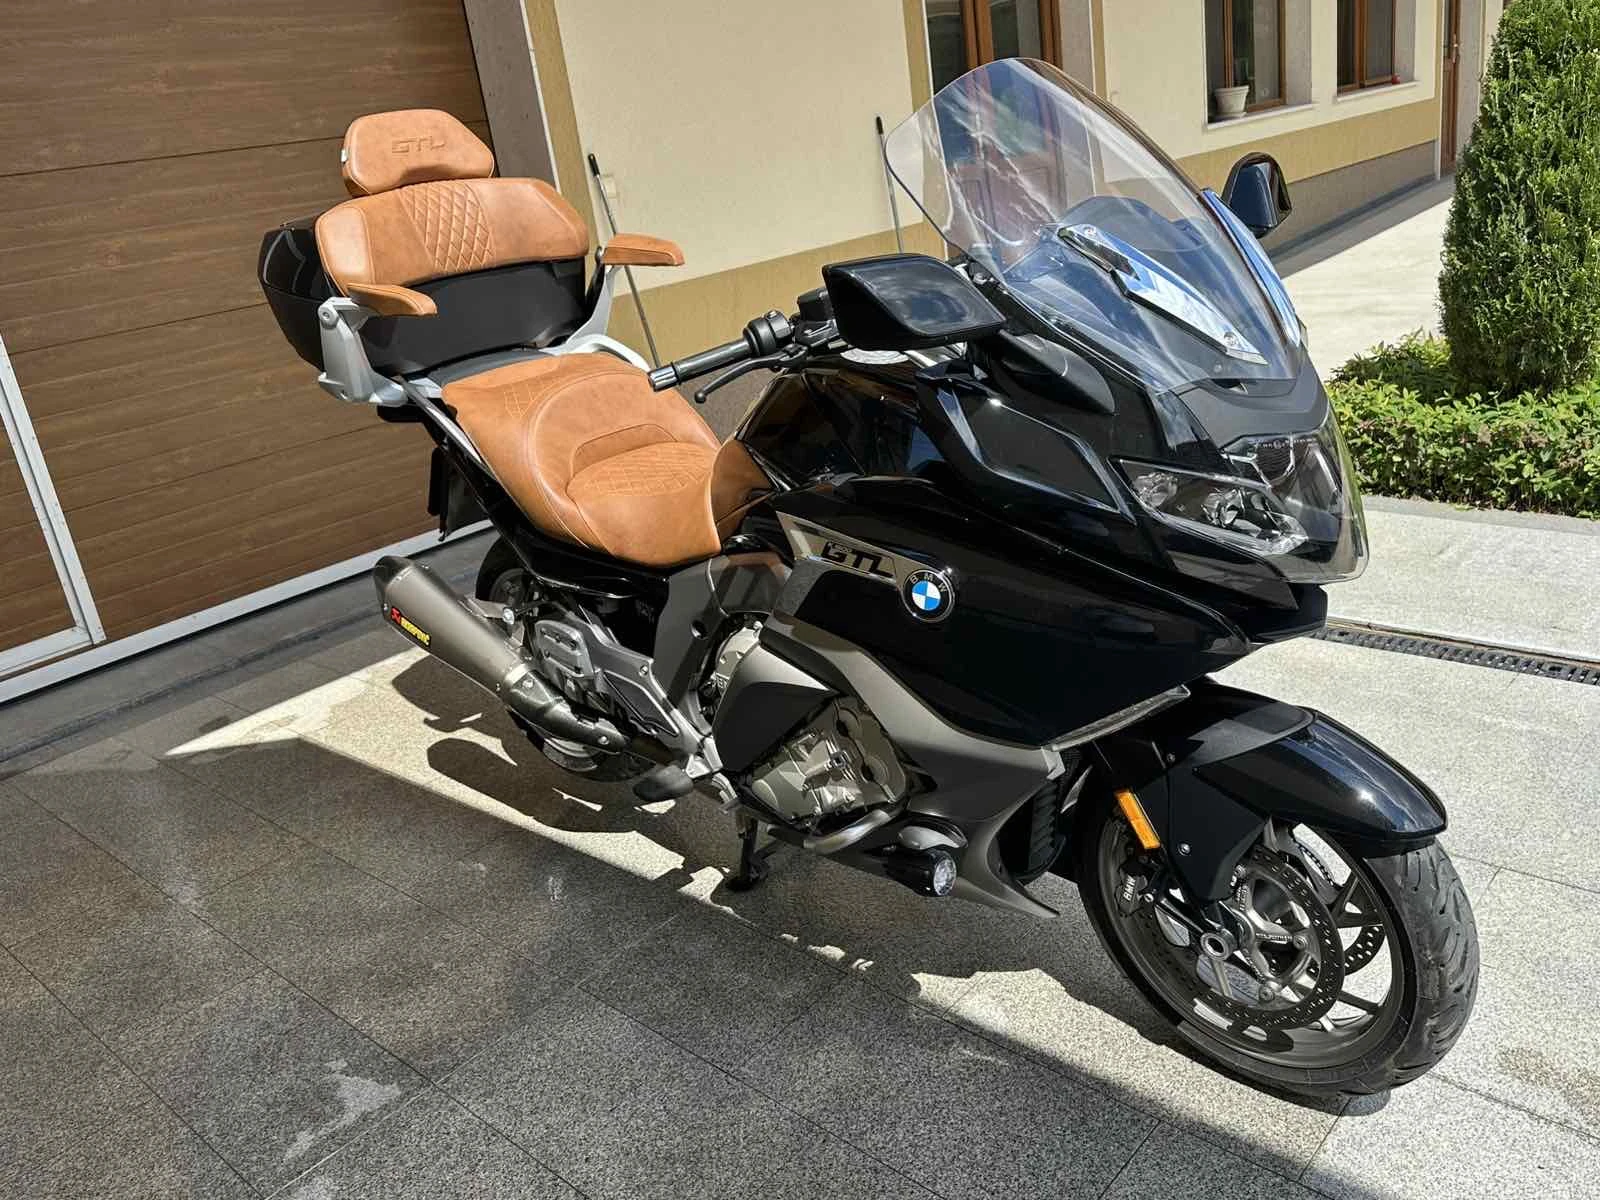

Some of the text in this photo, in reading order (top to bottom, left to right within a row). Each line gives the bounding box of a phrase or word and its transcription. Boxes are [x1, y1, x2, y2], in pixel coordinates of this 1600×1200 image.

[391, 136, 446, 154] GTL
[821, 541, 894, 577] GTL
[910, 572, 948, 593] BMW
[1123, 874, 1136, 901] BMW
